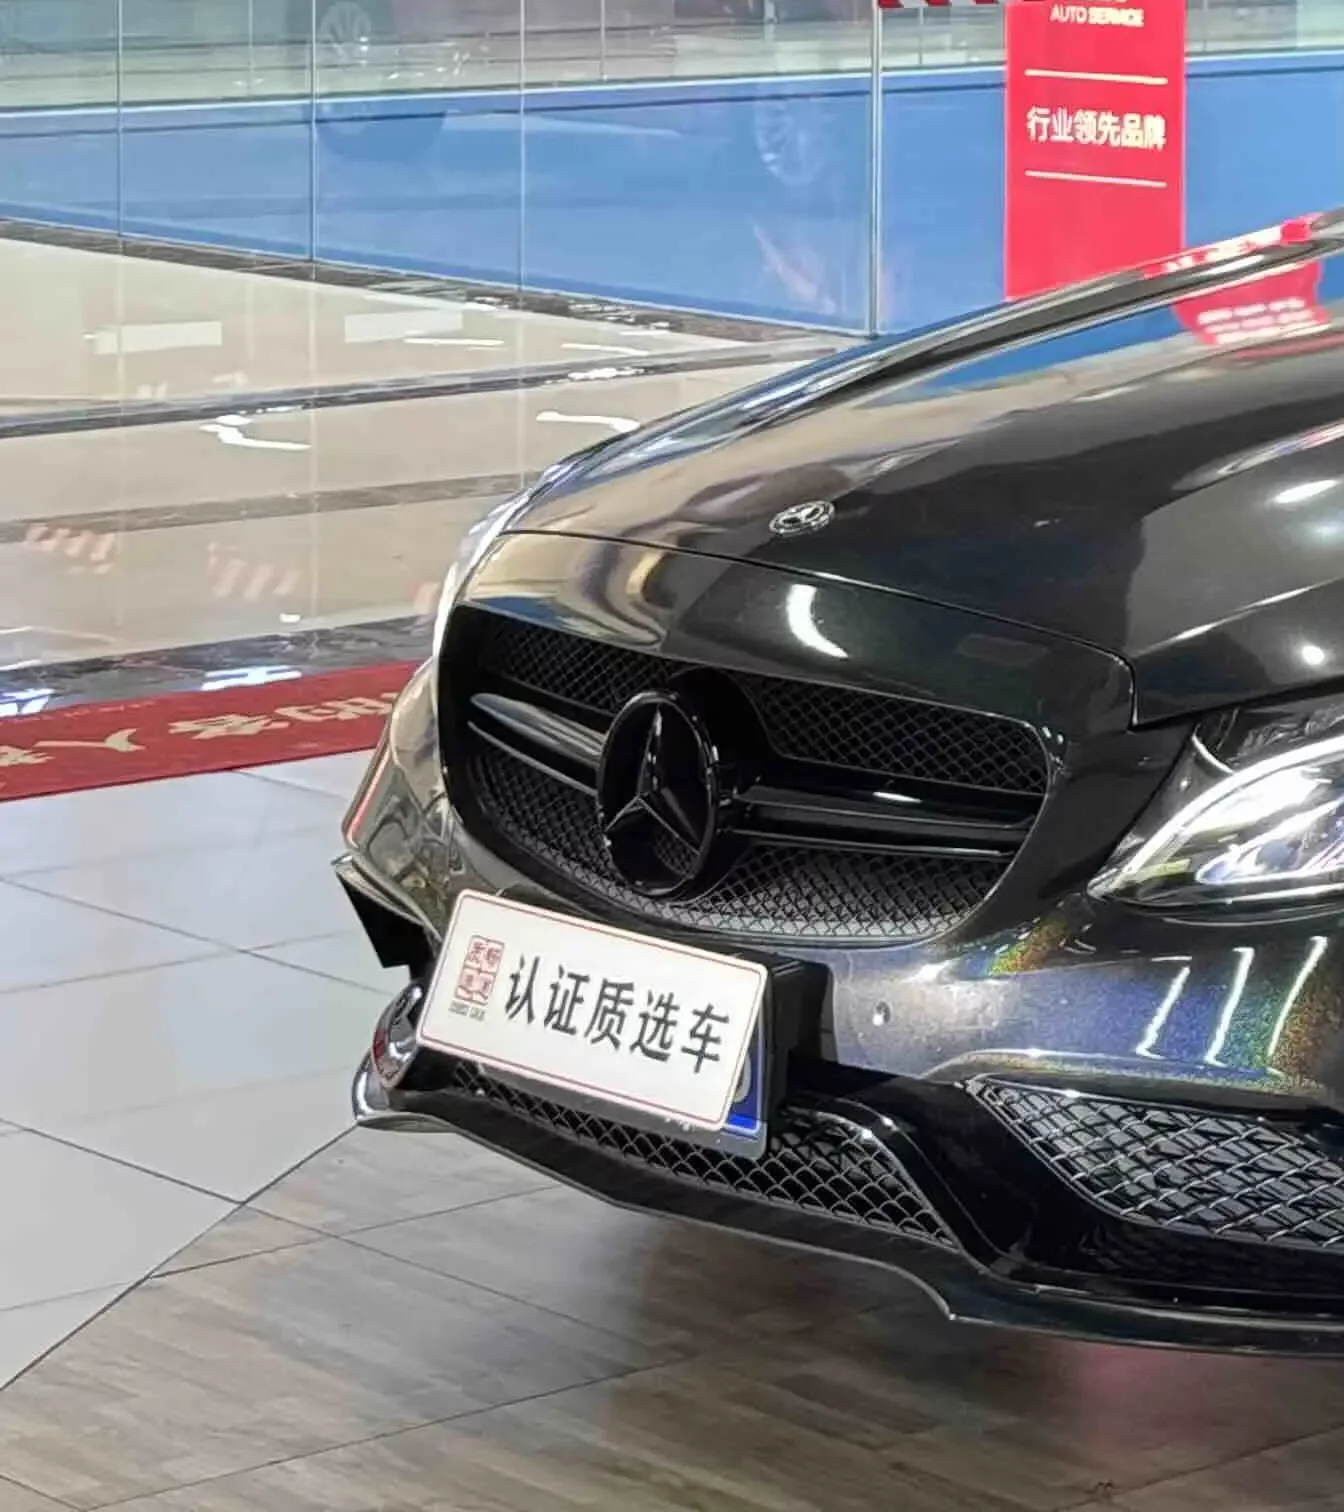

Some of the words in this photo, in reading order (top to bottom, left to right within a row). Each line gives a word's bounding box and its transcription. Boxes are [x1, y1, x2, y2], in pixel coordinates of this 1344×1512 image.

[1050, 5, 1087, 22] AUTO
[1088, 6, 1144, 27] SERVICE
[1026, 106, 1166, 151] 行业领先品牌
[504, 955, 731, 1075] 认证质选车
